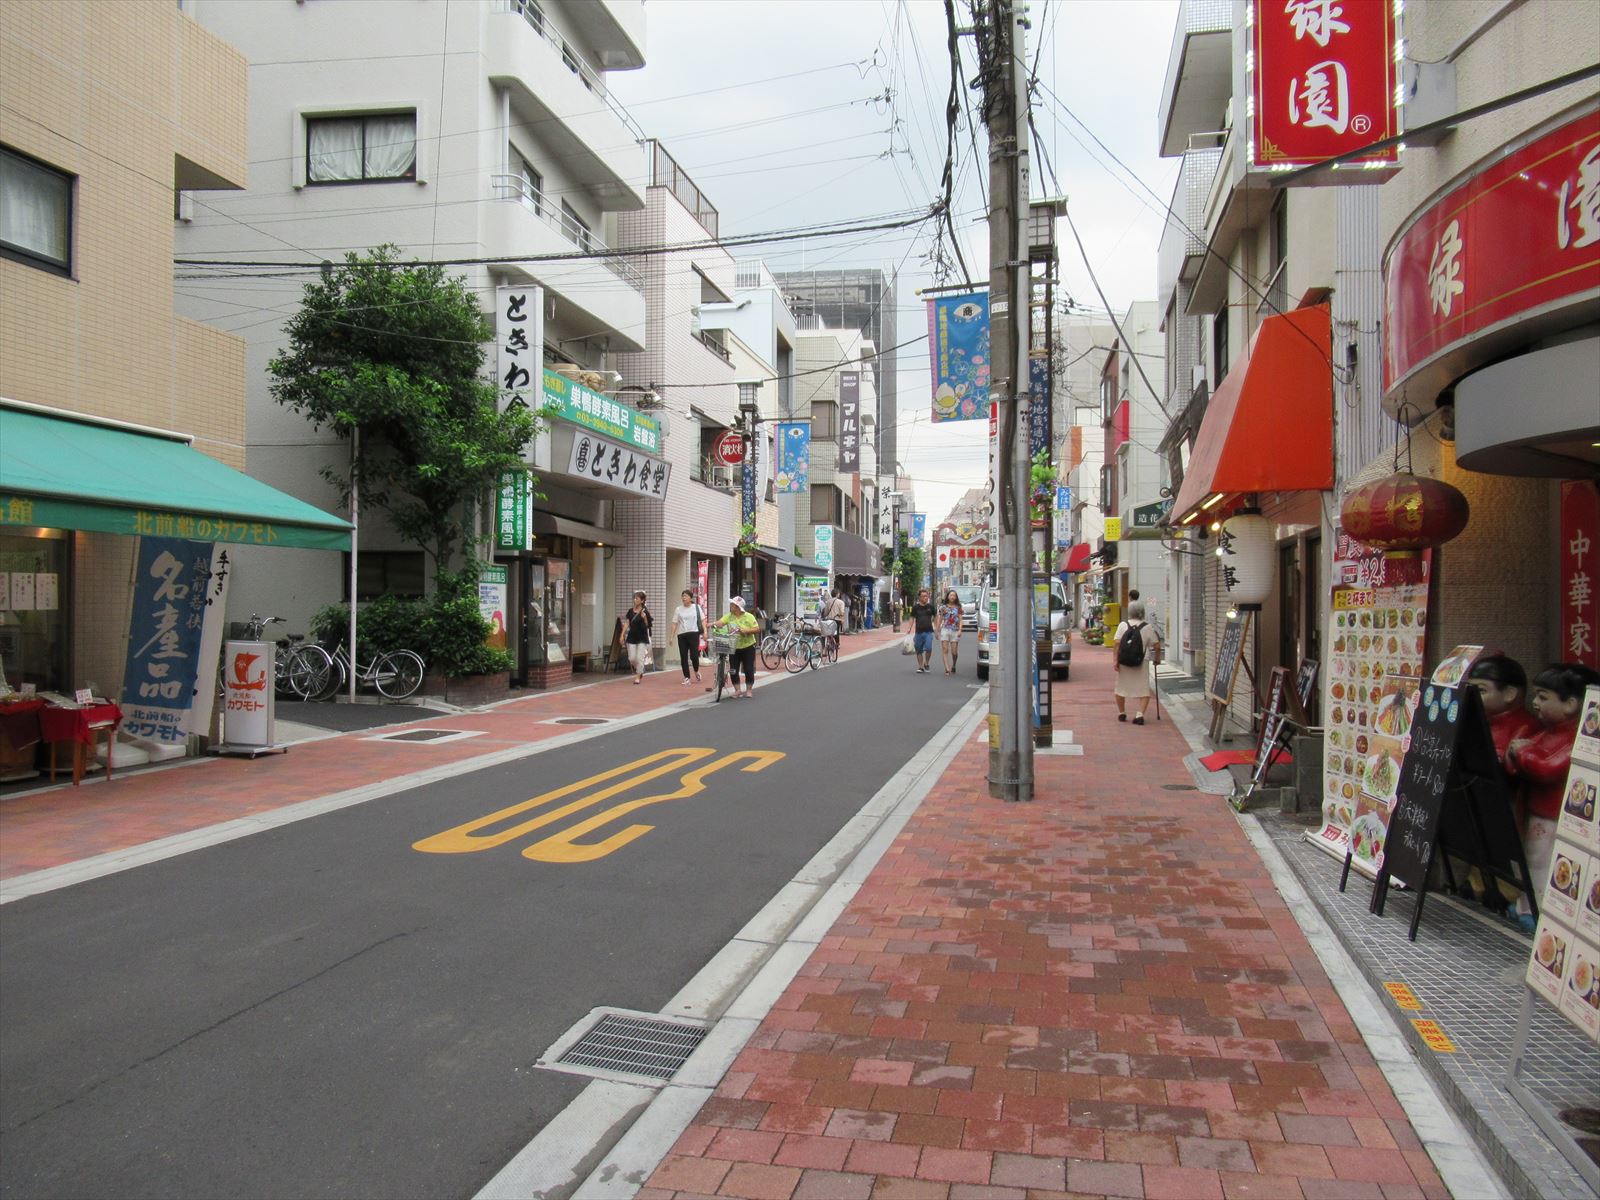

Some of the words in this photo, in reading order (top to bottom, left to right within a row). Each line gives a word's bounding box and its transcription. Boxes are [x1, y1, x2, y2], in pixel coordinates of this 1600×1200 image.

[591, 442, 666, 494] ときわ食堂
[133, 511, 280, 543] 北前船のカワモト
[1568, 528, 1593, 664] 中華家
[133, 550, 190, 699] 名産品
[227, 700, 265, 712] カワモト
[124, 720, 187, 741] カワモト
